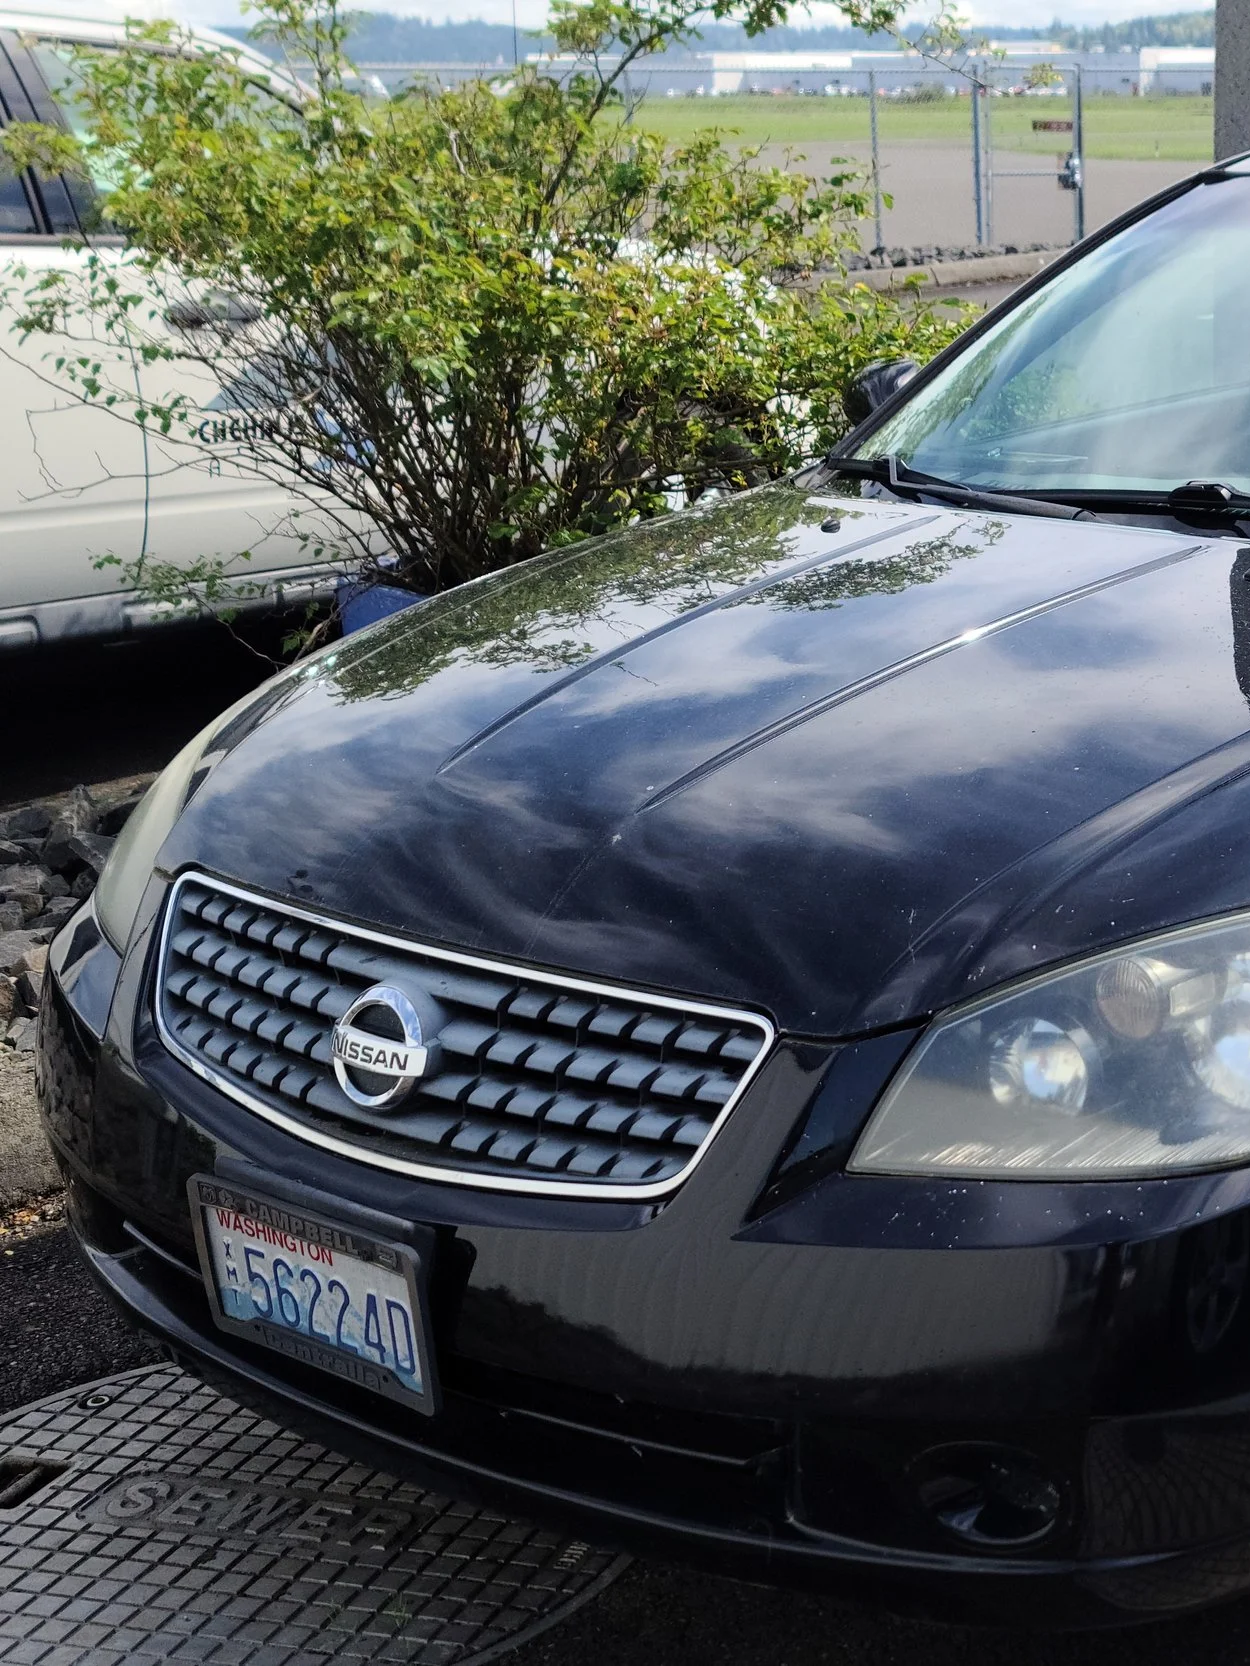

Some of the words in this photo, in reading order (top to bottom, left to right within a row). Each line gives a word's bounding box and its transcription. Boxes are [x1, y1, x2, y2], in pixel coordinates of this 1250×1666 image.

[332, 1030, 409, 1071] NISSAN
[216, 1208, 334, 1267] WASHINGTON
[246, 1198, 360, 1258] CAMPBELL
[244, 1246, 416, 1376] 56224D
[106, 1481, 413, 1552] SEWER
